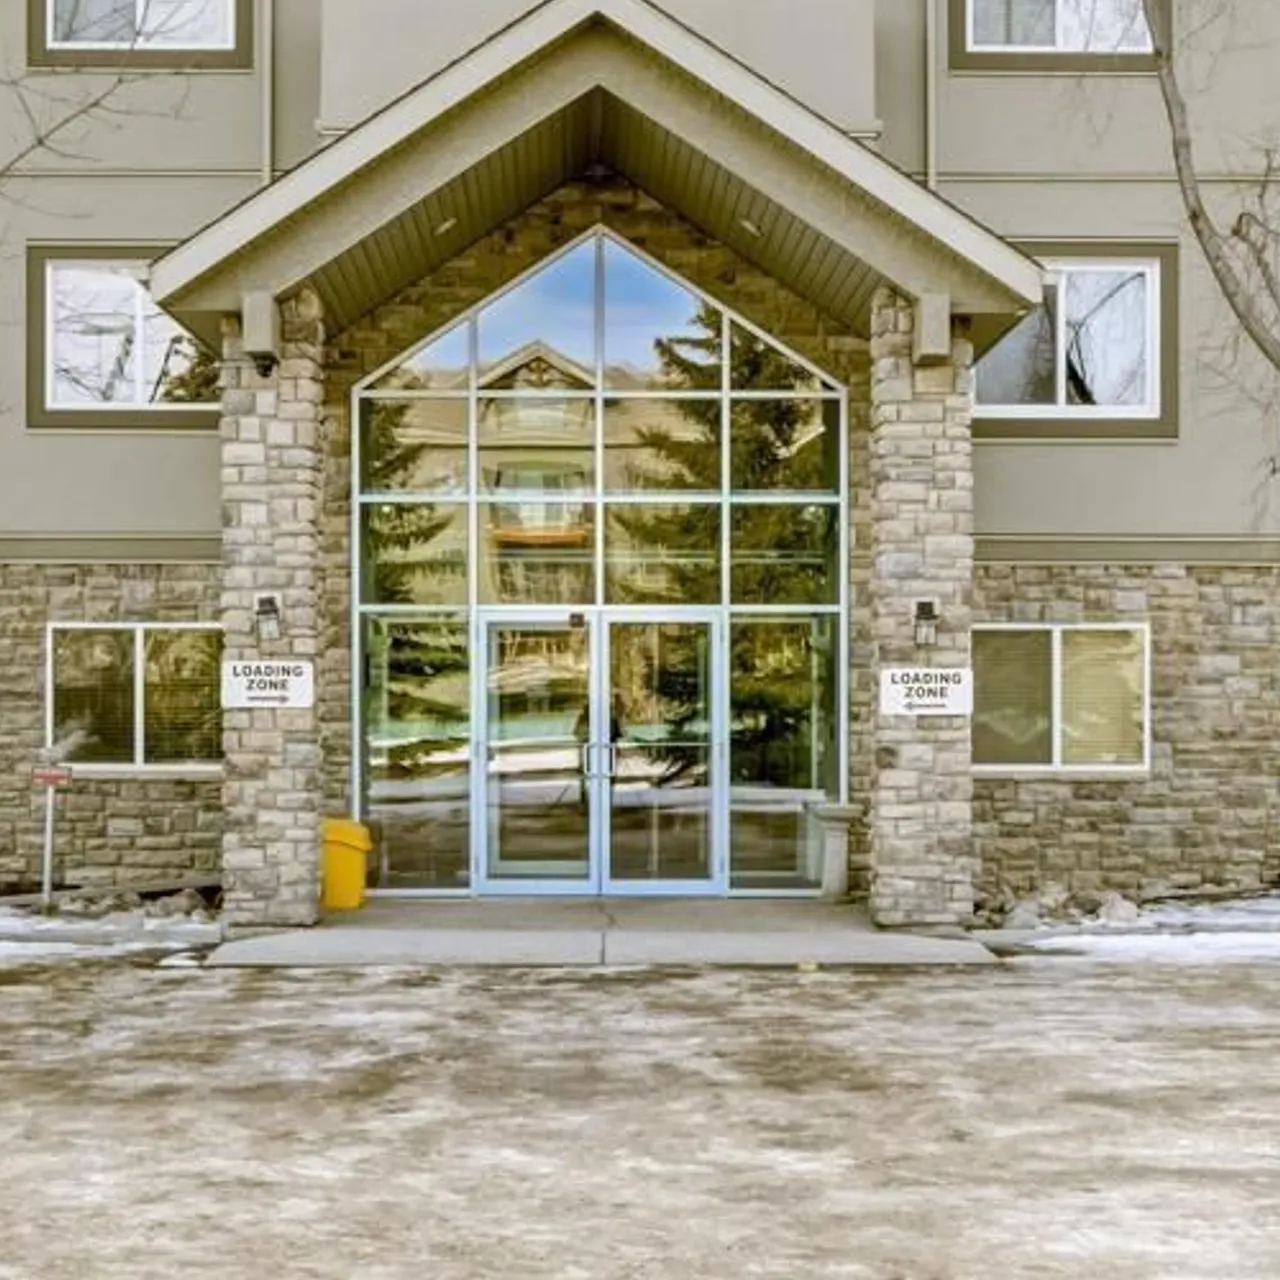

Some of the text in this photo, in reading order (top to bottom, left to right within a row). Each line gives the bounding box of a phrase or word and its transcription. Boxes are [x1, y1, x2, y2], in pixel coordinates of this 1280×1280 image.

[232, 665, 304, 677] LOADING
[246, 679, 288, 690] ZONE
[890, 672, 962, 685] LOADING
[903, 686, 948, 698] ZONE
